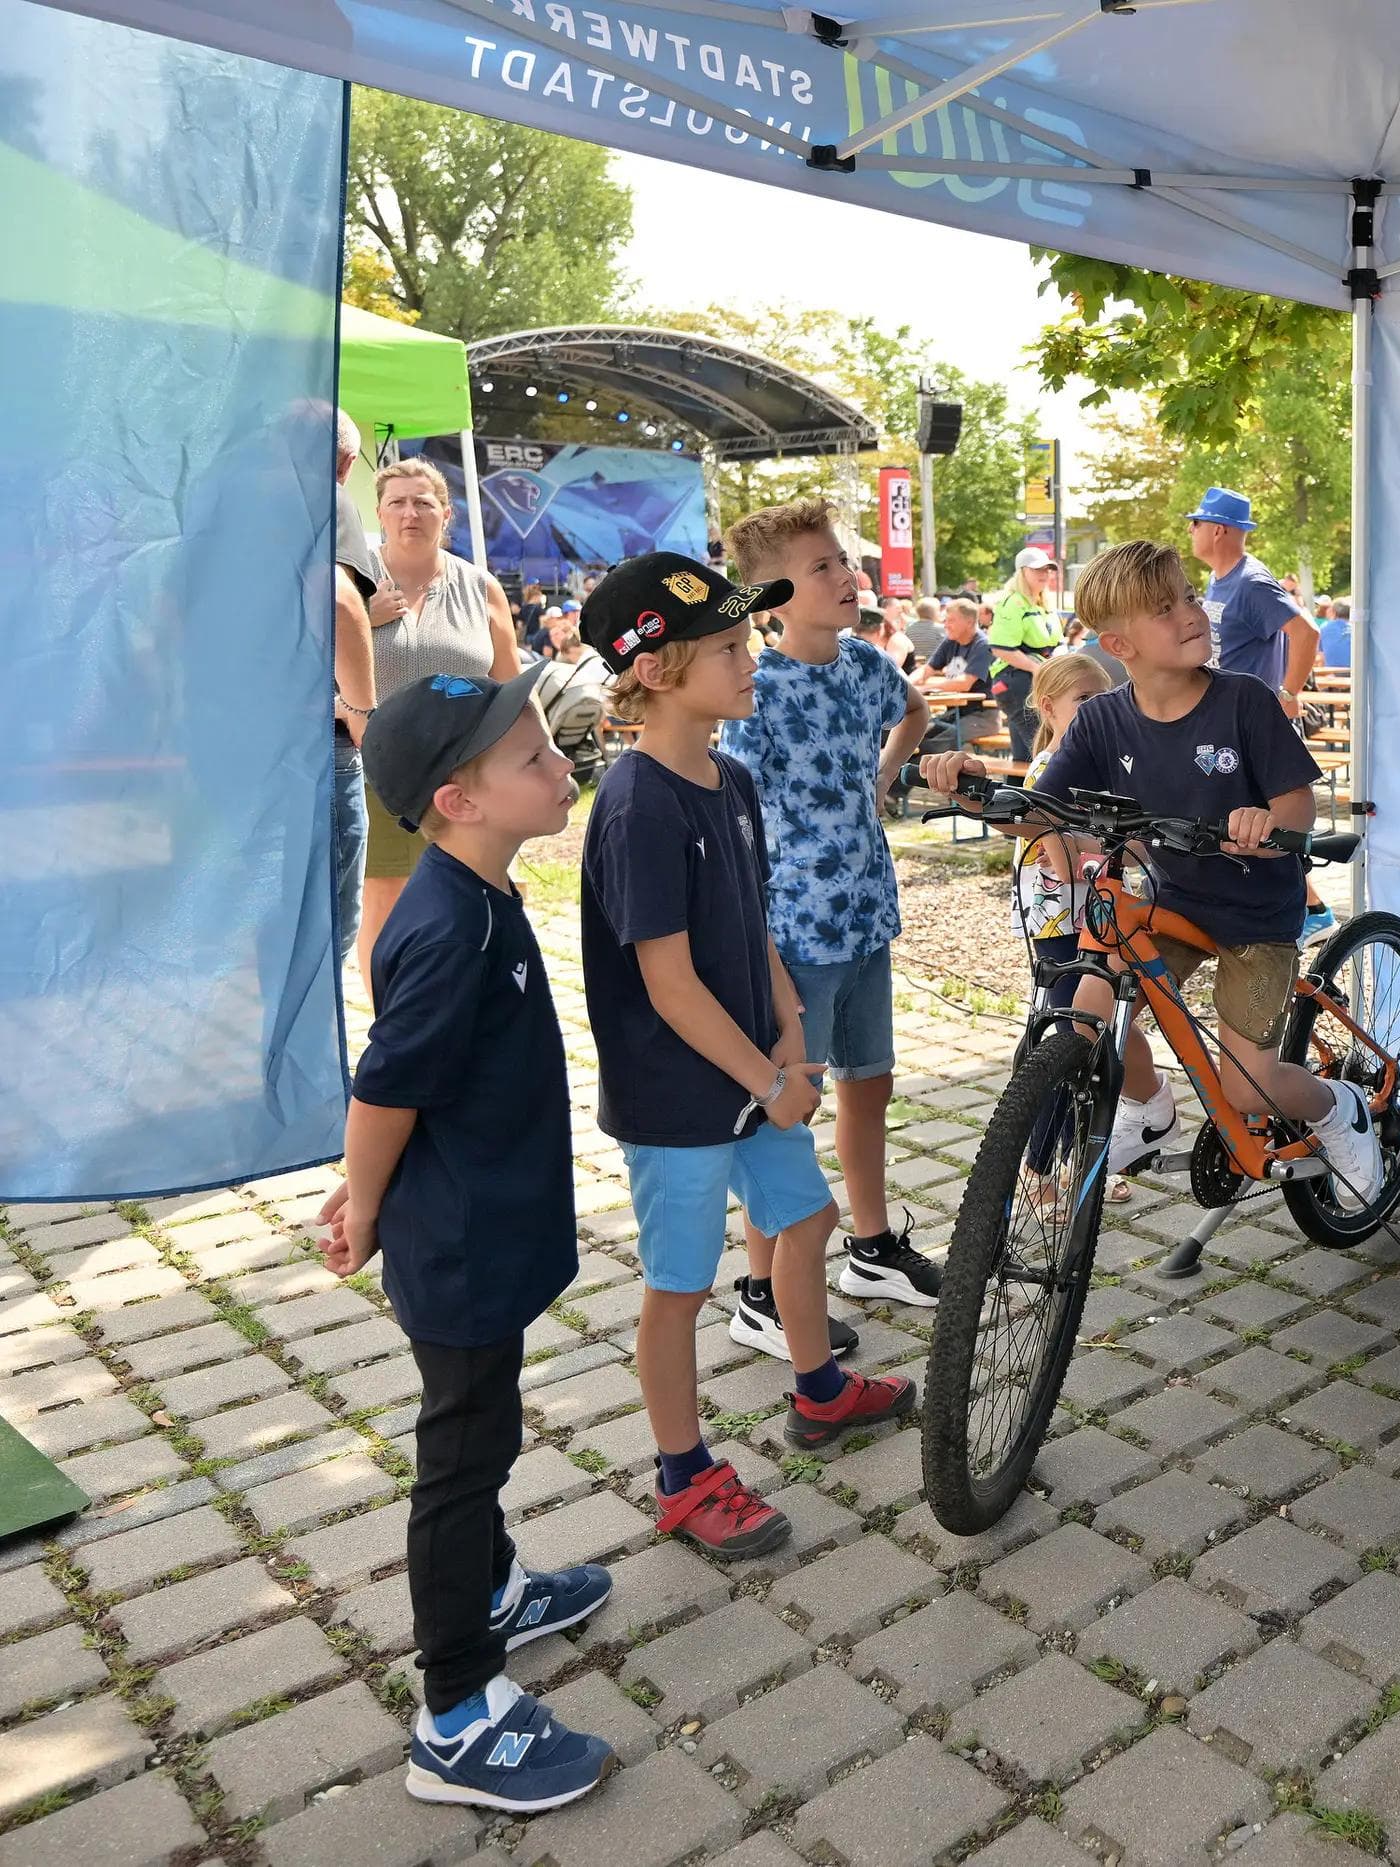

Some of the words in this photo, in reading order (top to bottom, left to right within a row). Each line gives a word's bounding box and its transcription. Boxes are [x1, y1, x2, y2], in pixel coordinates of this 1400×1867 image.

[487, 444, 544, 462] ERC
[675, 577, 694, 593] GP
[516, 1596, 552, 1627] N
[486, 1732, 535, 1767] N
